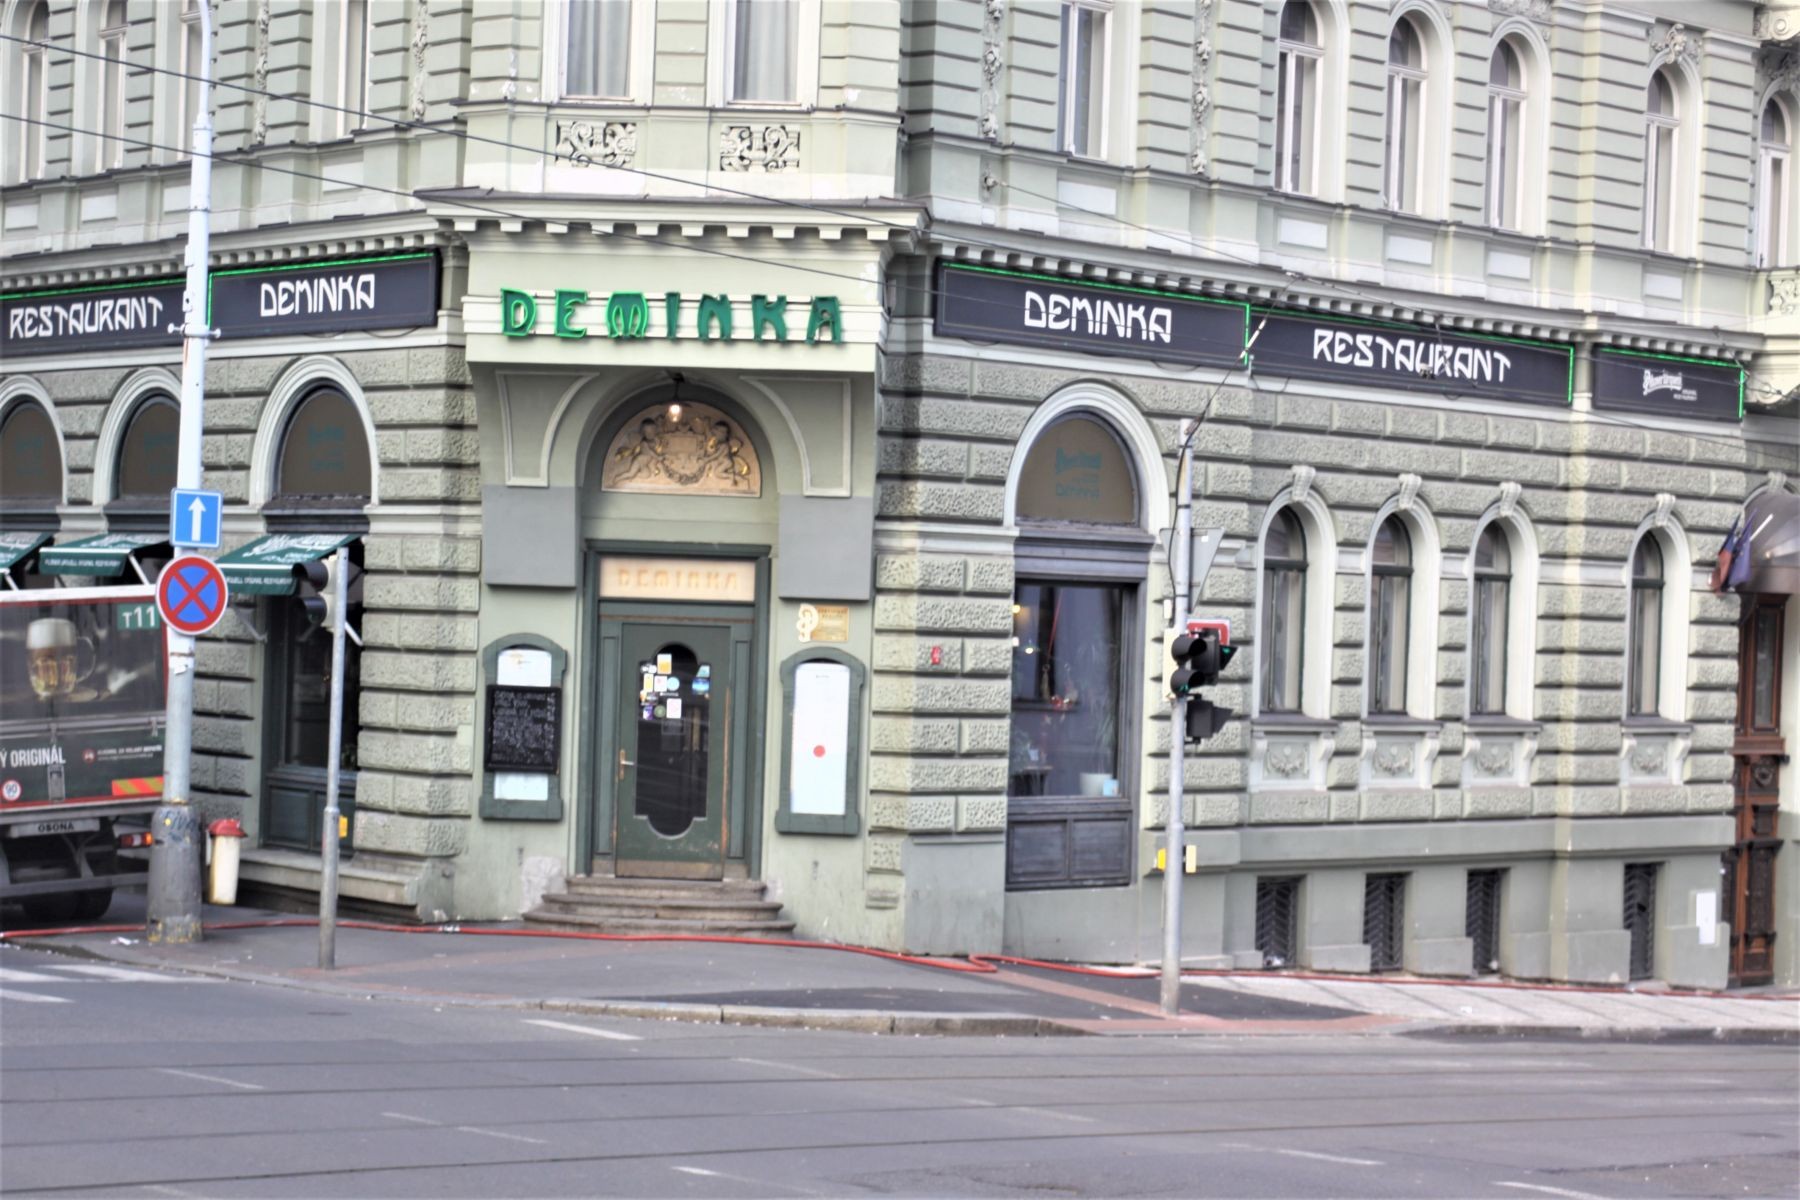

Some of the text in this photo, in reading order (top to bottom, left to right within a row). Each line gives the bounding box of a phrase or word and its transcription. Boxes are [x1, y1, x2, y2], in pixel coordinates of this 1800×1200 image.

[9, 297, 163, 339] RESTAURANT
[259, 273, 375, 318] DEMINKA
[500, 288, 842, 344] DEMINKA
[1024, 291, 1171, 343] DEMINKA
[1312, 328, 1512, 382] RESTAURANT
[122, 605, 156, 628] T11
